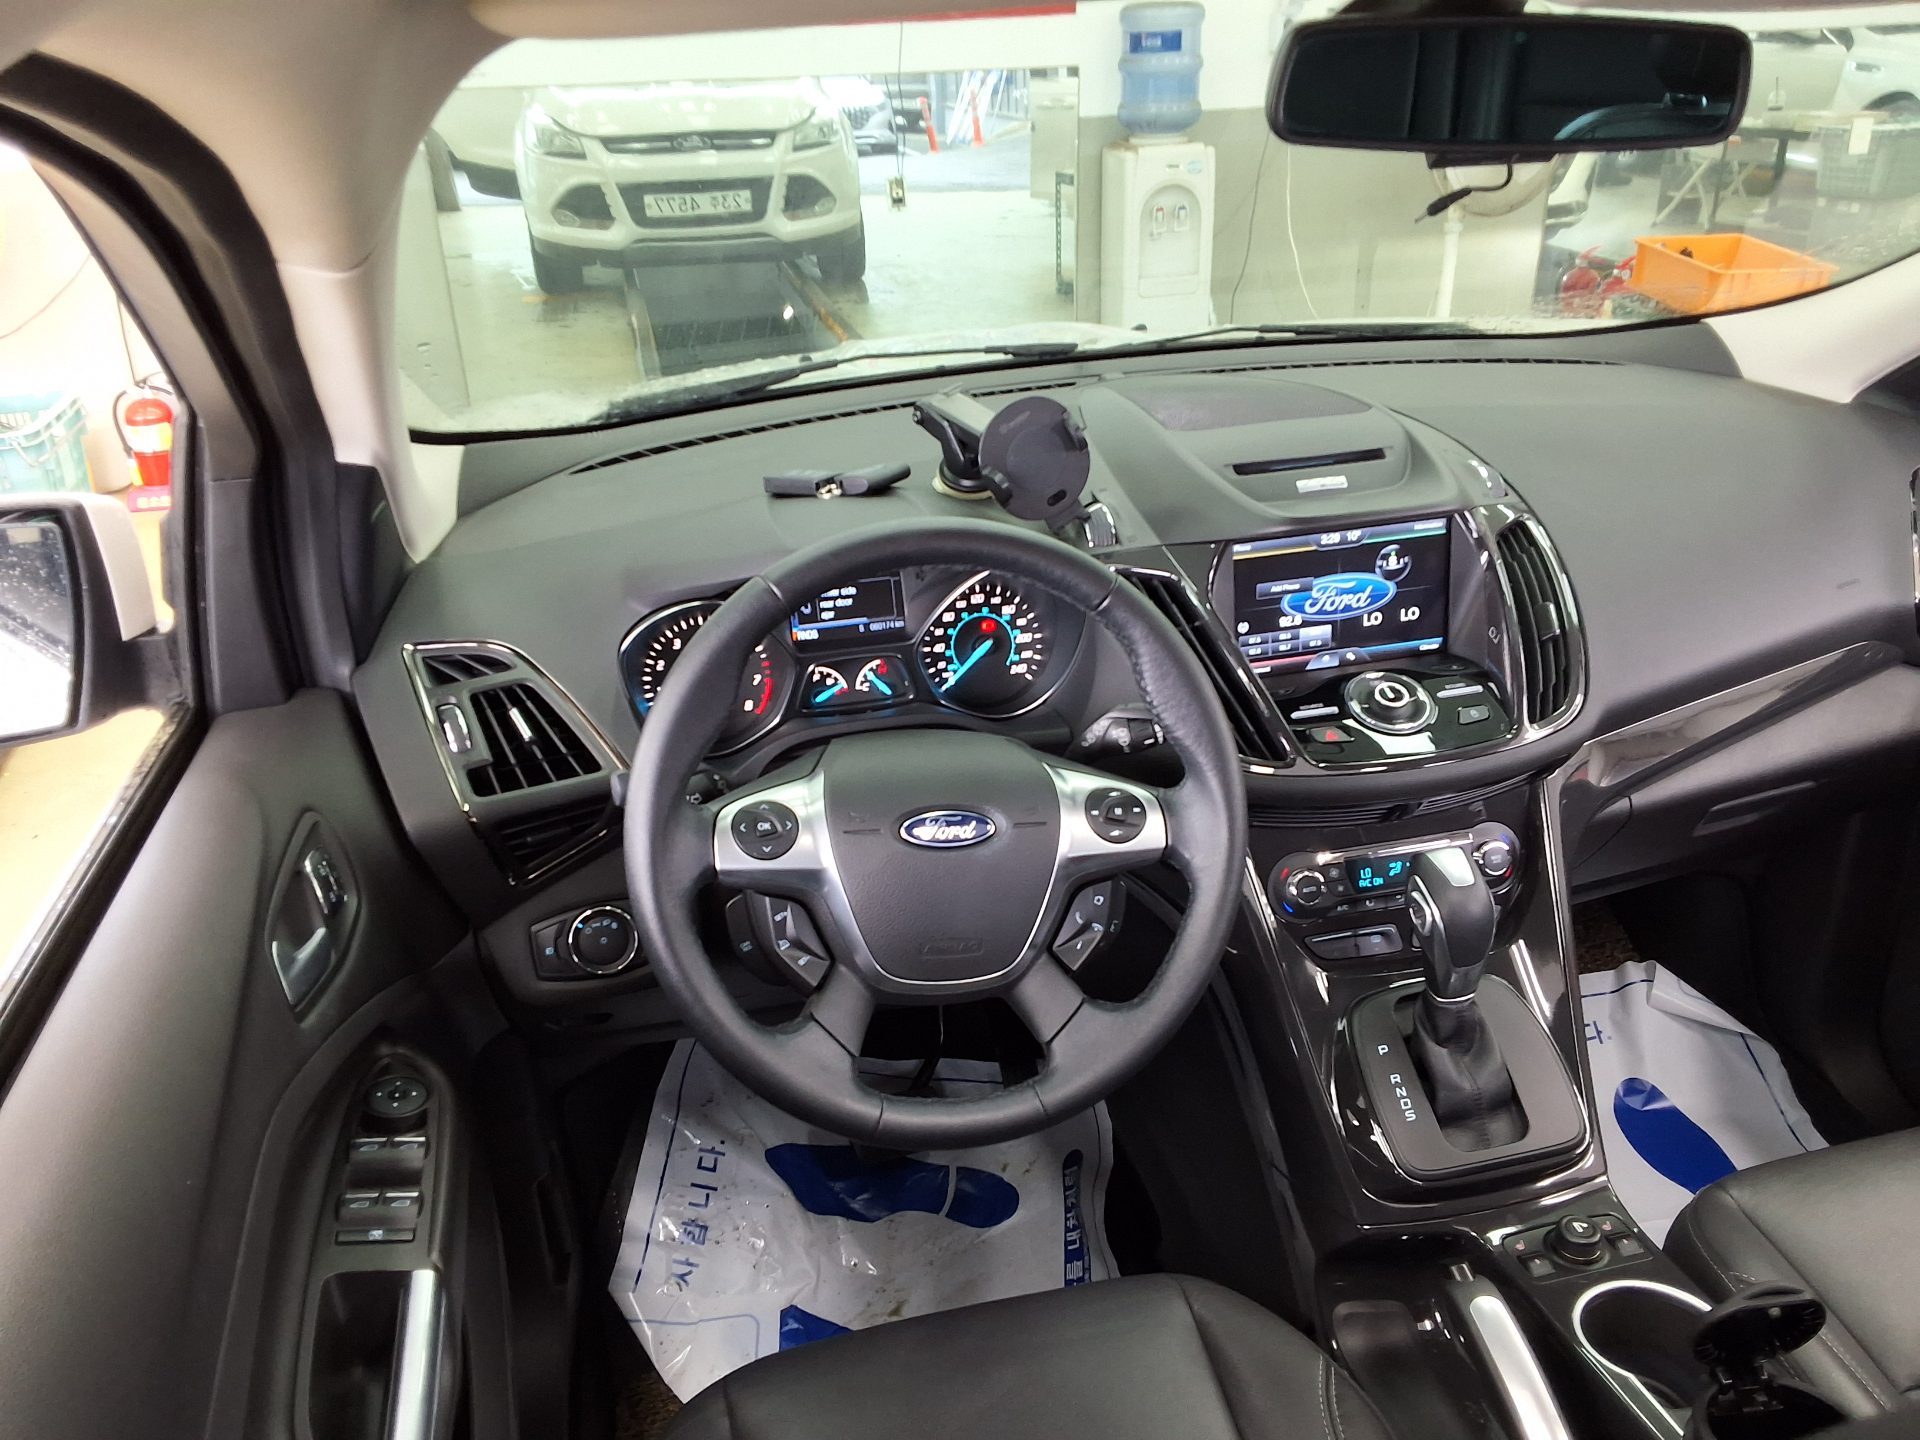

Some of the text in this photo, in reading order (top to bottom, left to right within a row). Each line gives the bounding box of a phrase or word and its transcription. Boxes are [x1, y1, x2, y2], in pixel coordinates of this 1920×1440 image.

[1304, 580, 1374, 614] Ford
[1362, 611, 1383, 627] LO
[1400, 606, 1420, 622] LO
[753, 674, 763, 686] 7
[757, 822, 771, 831] OK
[912, 816, 976, 841] Ford
[1378, 1044, 1389, 1055] P
[1390, 1074, 1402, 1085] R
[1395, 1087, 1407, 1098] N
[1400, 1098, 1412, 1109] D
[1404, 1110, 1416, 1121] S
